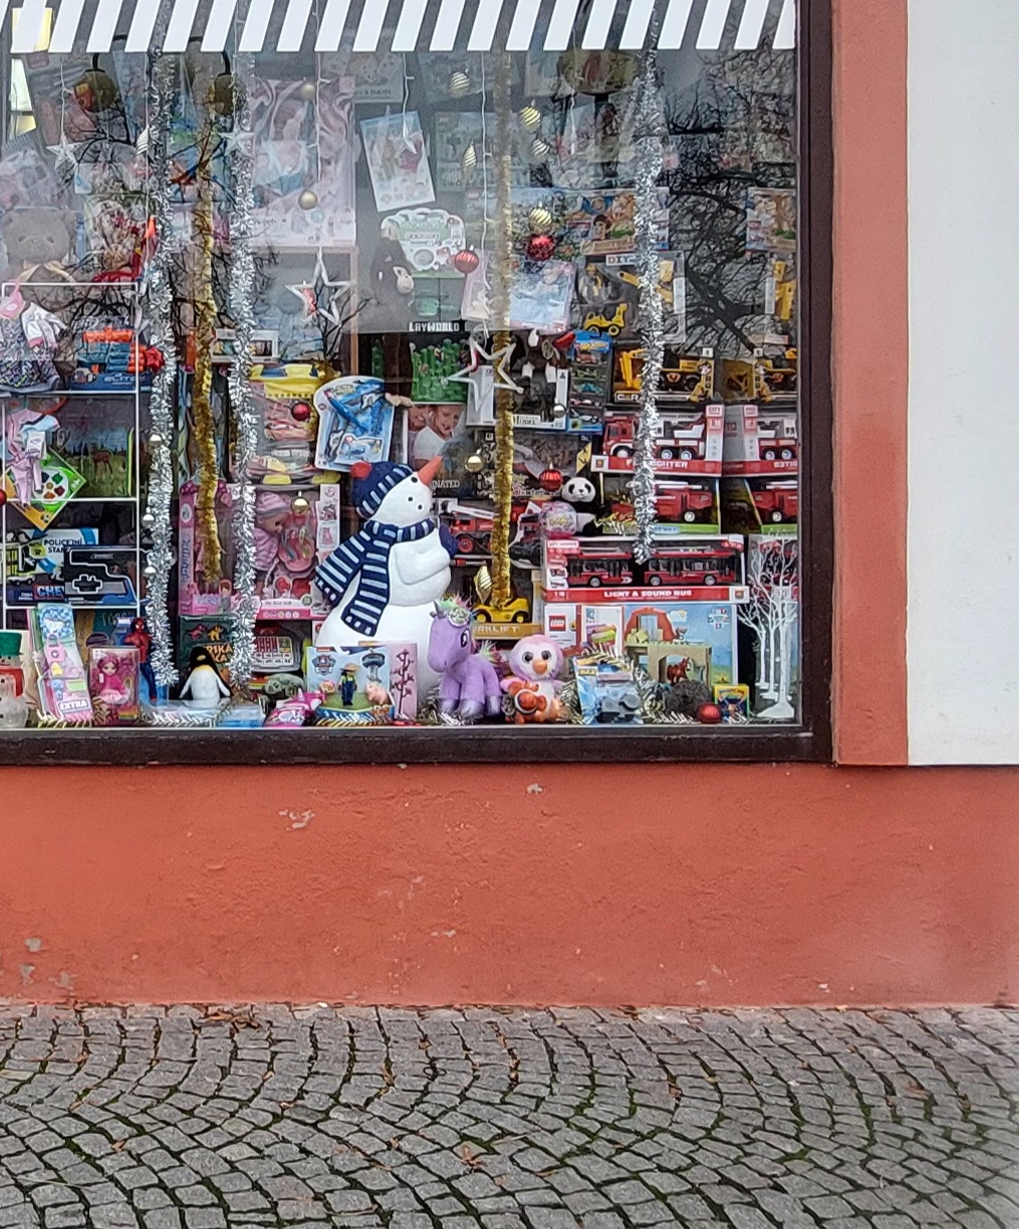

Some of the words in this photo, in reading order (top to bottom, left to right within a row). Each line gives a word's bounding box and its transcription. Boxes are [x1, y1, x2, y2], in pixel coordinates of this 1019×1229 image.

[604, 590, 629, 598] LIGHT
[641, 590, 672, 598] SOUND
[674, 589, 693, 597] BUS
[59, 700, 88, 711] EXTRA
